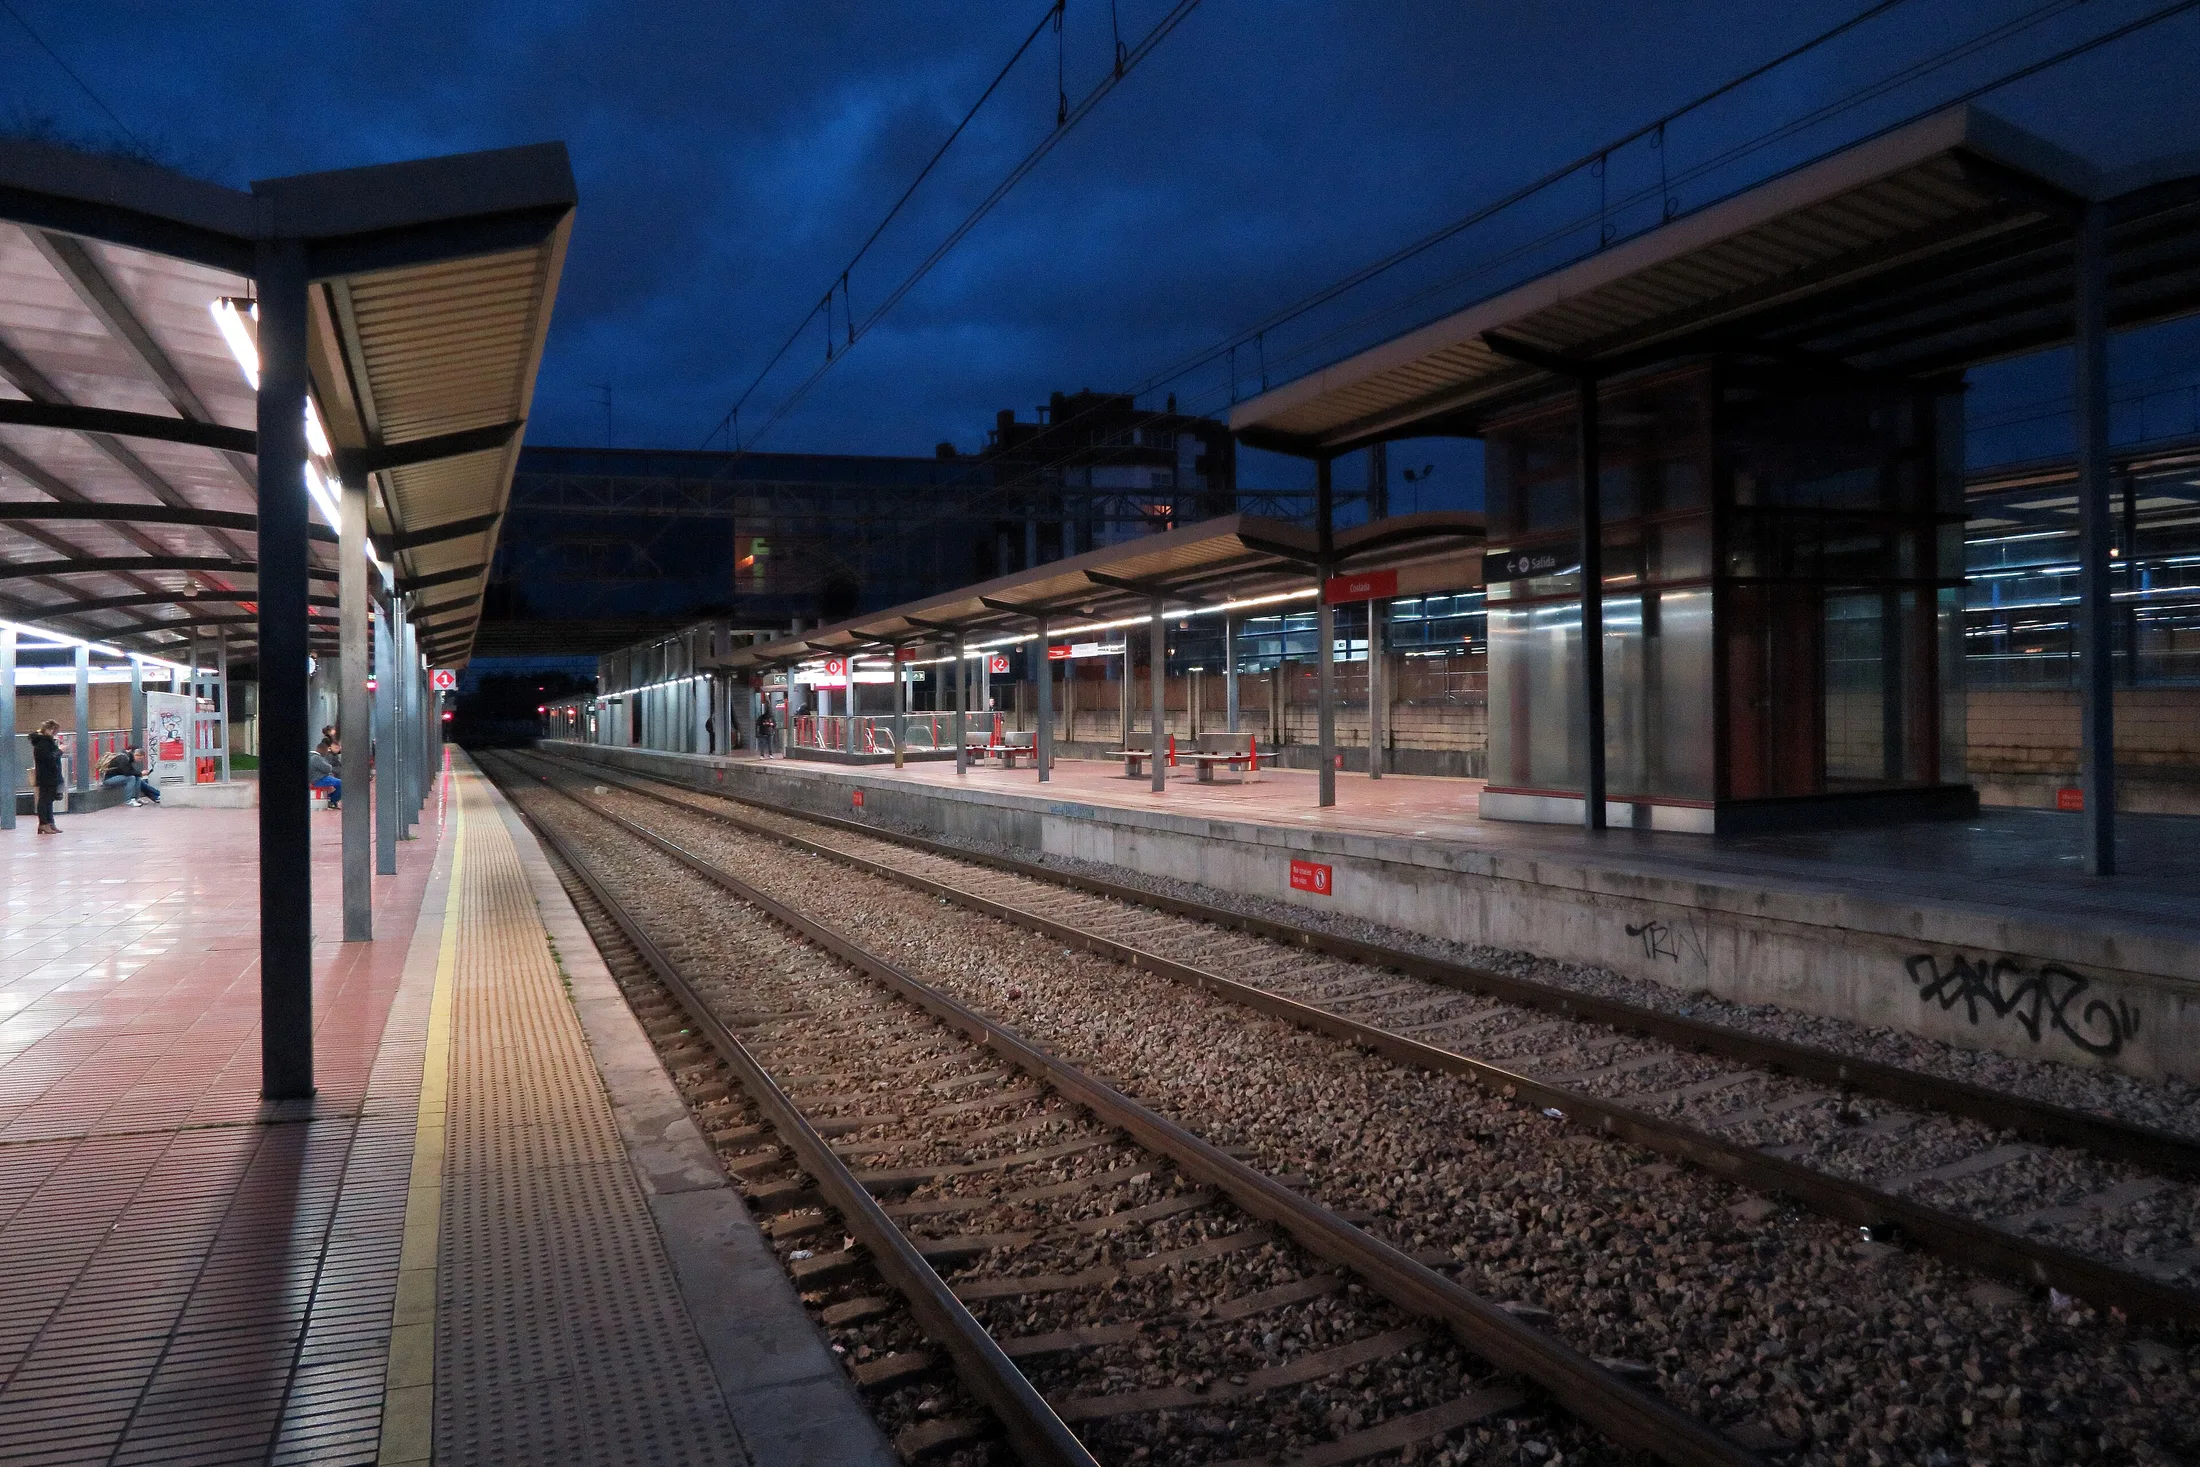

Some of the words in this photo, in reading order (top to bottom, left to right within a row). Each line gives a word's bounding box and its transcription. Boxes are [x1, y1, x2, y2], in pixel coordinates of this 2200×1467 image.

[1531, 556, 1555, 569] Salida
[1350, 582, 1370, 592] Coslada
[830, 662, 837, 672] 0
[998, 660, 1004, 668] 2
[441, 674, 449, 684] 1
